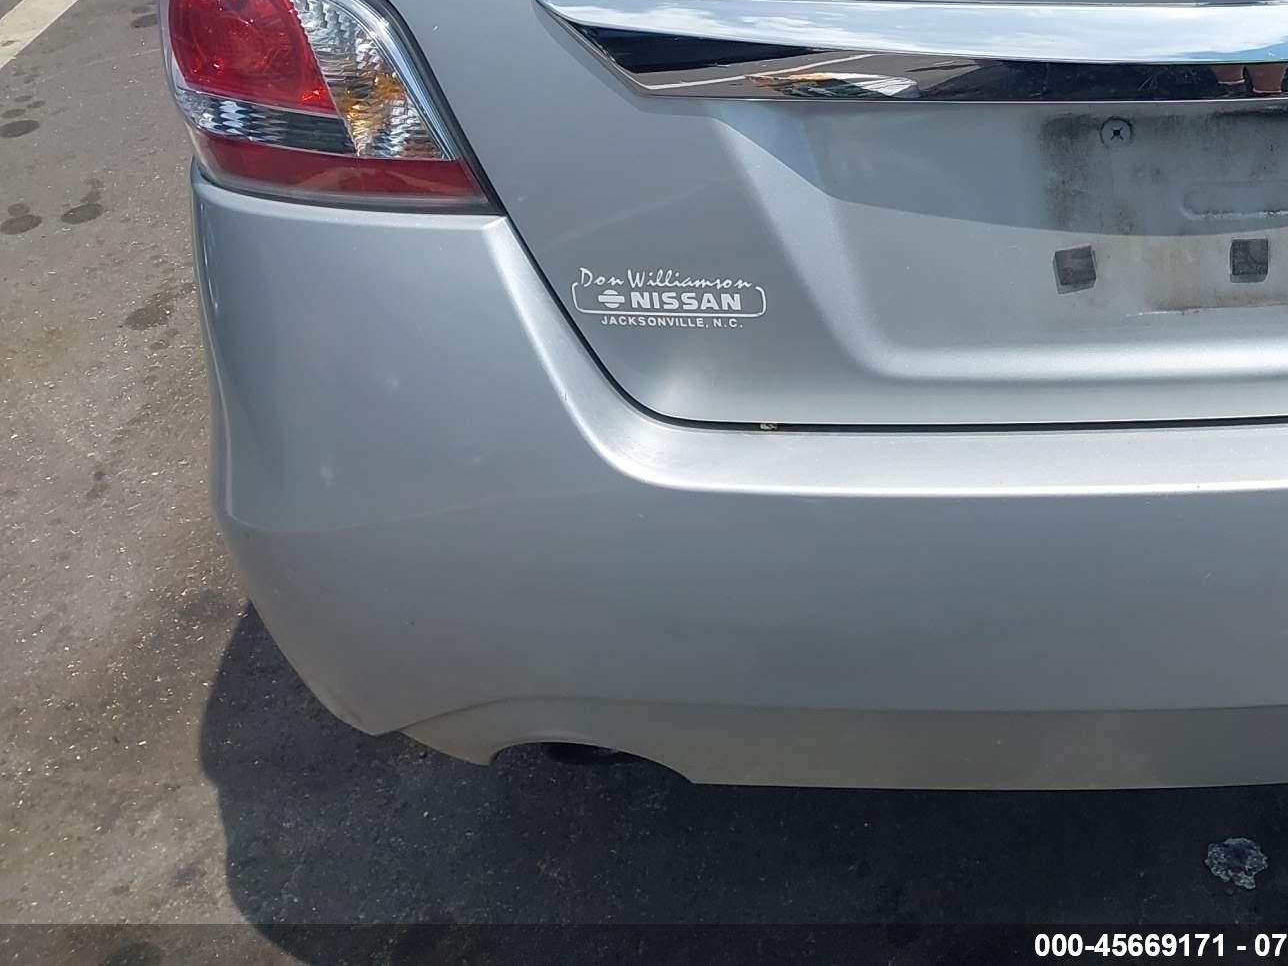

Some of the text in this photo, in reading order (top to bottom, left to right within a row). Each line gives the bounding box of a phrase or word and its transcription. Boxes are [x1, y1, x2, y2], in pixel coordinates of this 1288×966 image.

[579, 267, 753, 289] Don Williamson
[630, 291, 742, 311] NISSAN
[601, 316, 744, 328] JACKSONVILLE, N.C.
